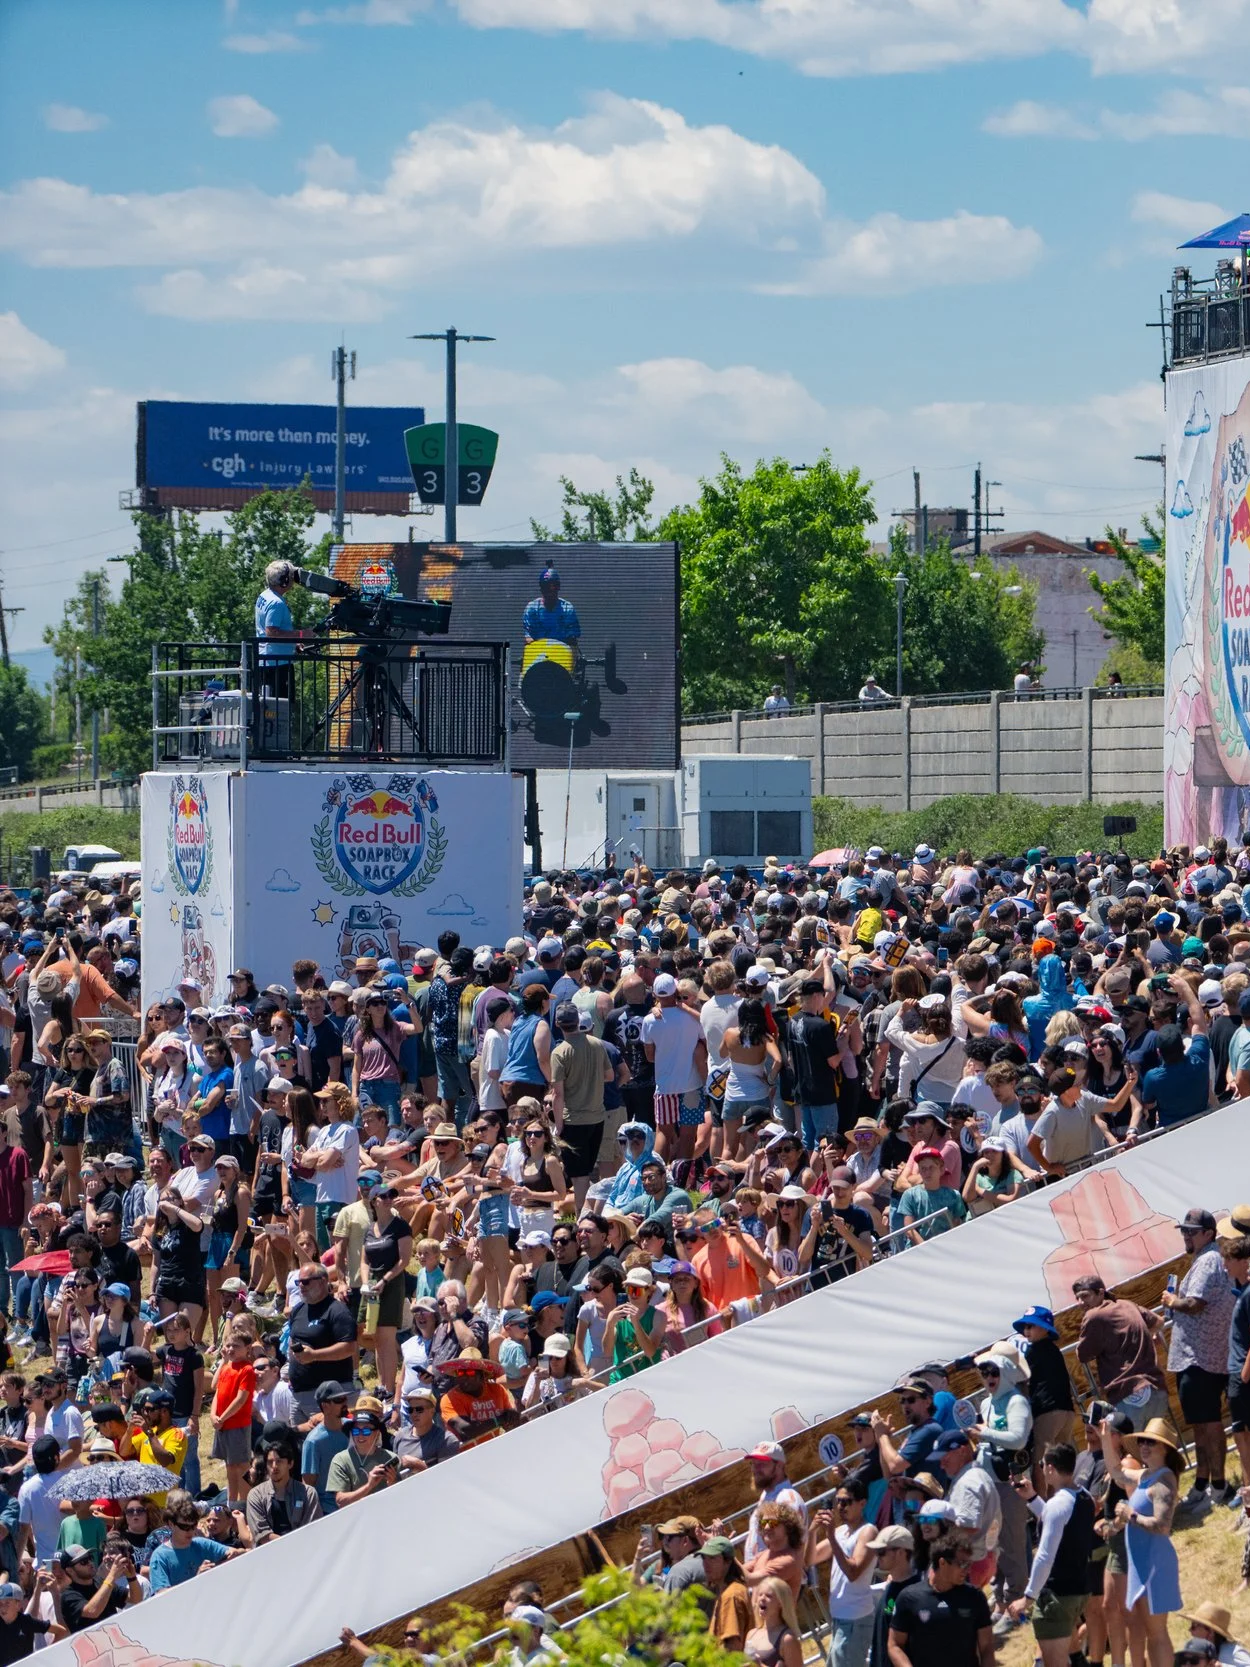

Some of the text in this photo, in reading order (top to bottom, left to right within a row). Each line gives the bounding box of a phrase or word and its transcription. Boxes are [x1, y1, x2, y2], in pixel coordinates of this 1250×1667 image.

[208, 427, 232, 441] It's
[235, 429, 275, 443] more
[278, 428, 313, 444] than
[421, 437, 440, 460] G
[465, 438, 484, 461] G
[212, 453, 364, 478] cgh Injury Lawers
[423, 471, 437, 493] 3
[467, 471, 482, 494] 3
[175, 822, 205, 845] Red Bull
[339, 823, 421, 844] Red Bull
[350, 847, 411, 864] SOAPBOX
[185, 864, 198, 880] RACE
[363, 864, 397, 881] RACE
[782, 1255, 793, 1272] 10
[1013, 1338, 1027, 1354] 10
[823, 1440, 839, 1460] 10
